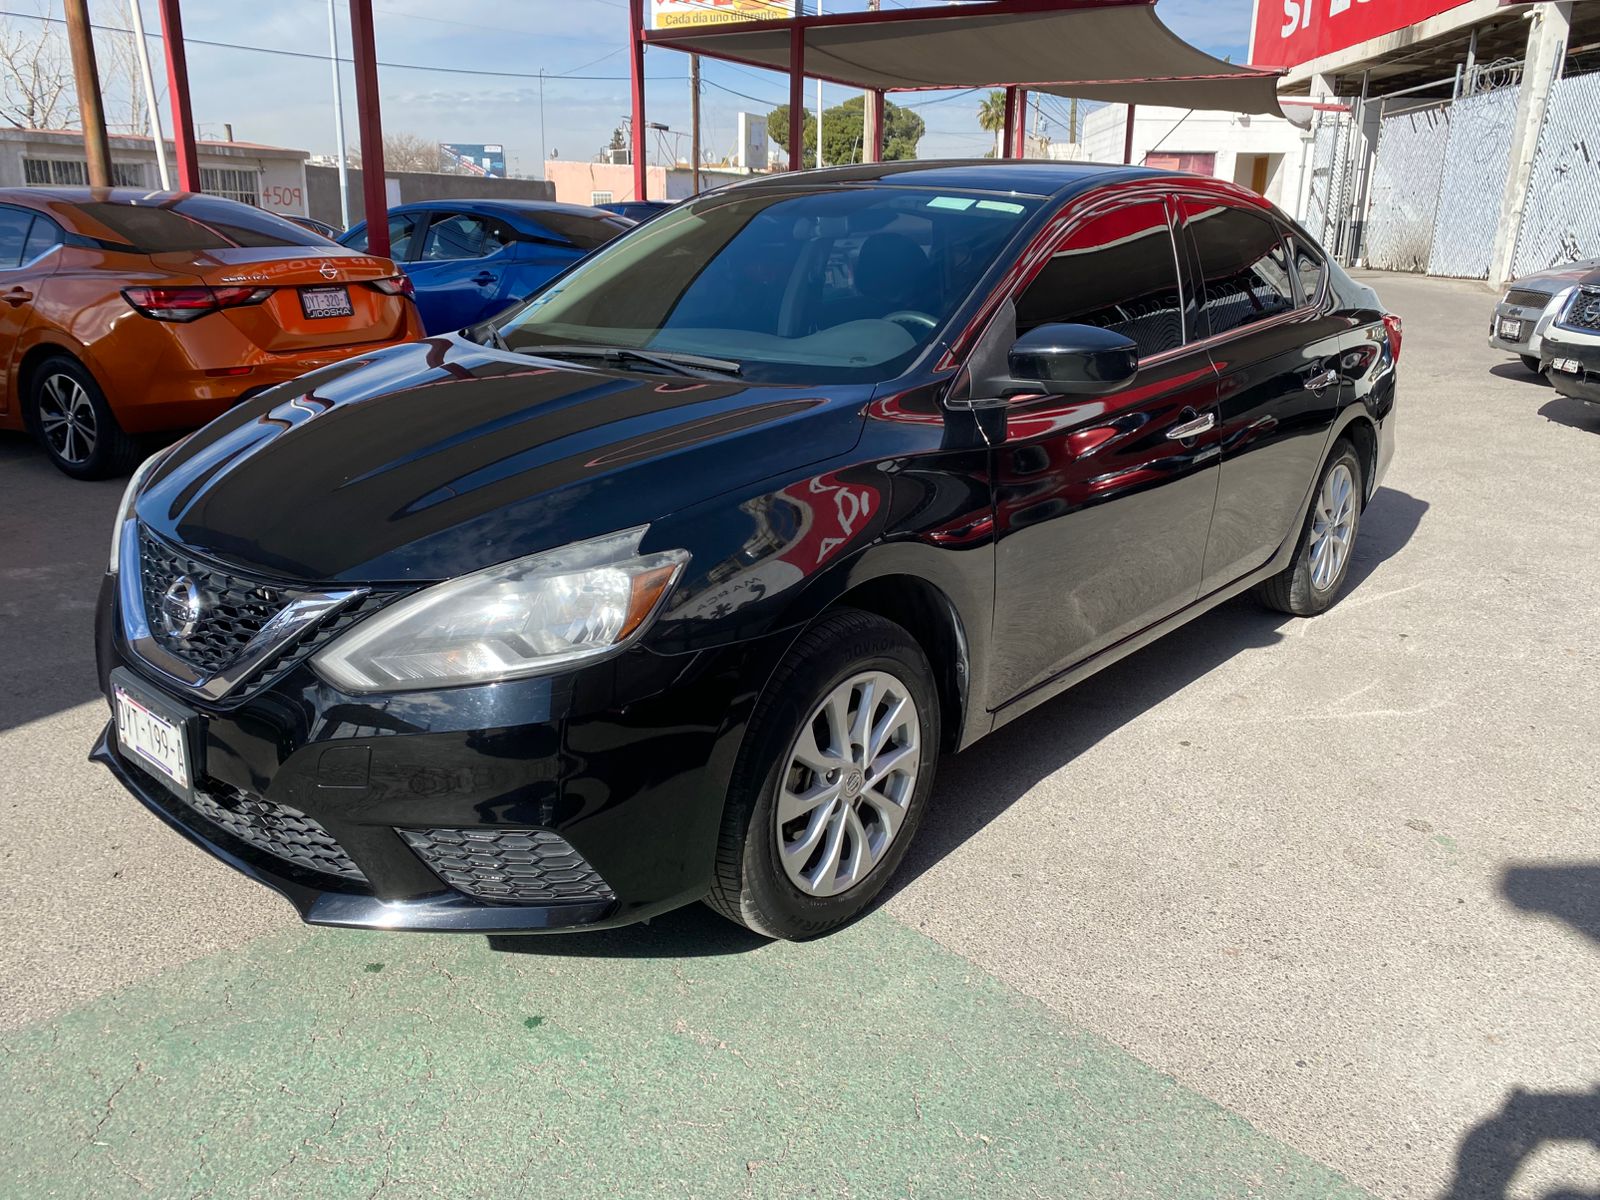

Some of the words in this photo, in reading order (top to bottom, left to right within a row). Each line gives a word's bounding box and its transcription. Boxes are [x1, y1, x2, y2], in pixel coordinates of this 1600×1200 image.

[665, 13, 690, 26] Cada
[709, 12, 729, 22] uno
[262, 186, 302, 207] 4509
[310, 307, 351, 318] JIDOSHA
[117, 698, 187, 776] DYT-199-A
